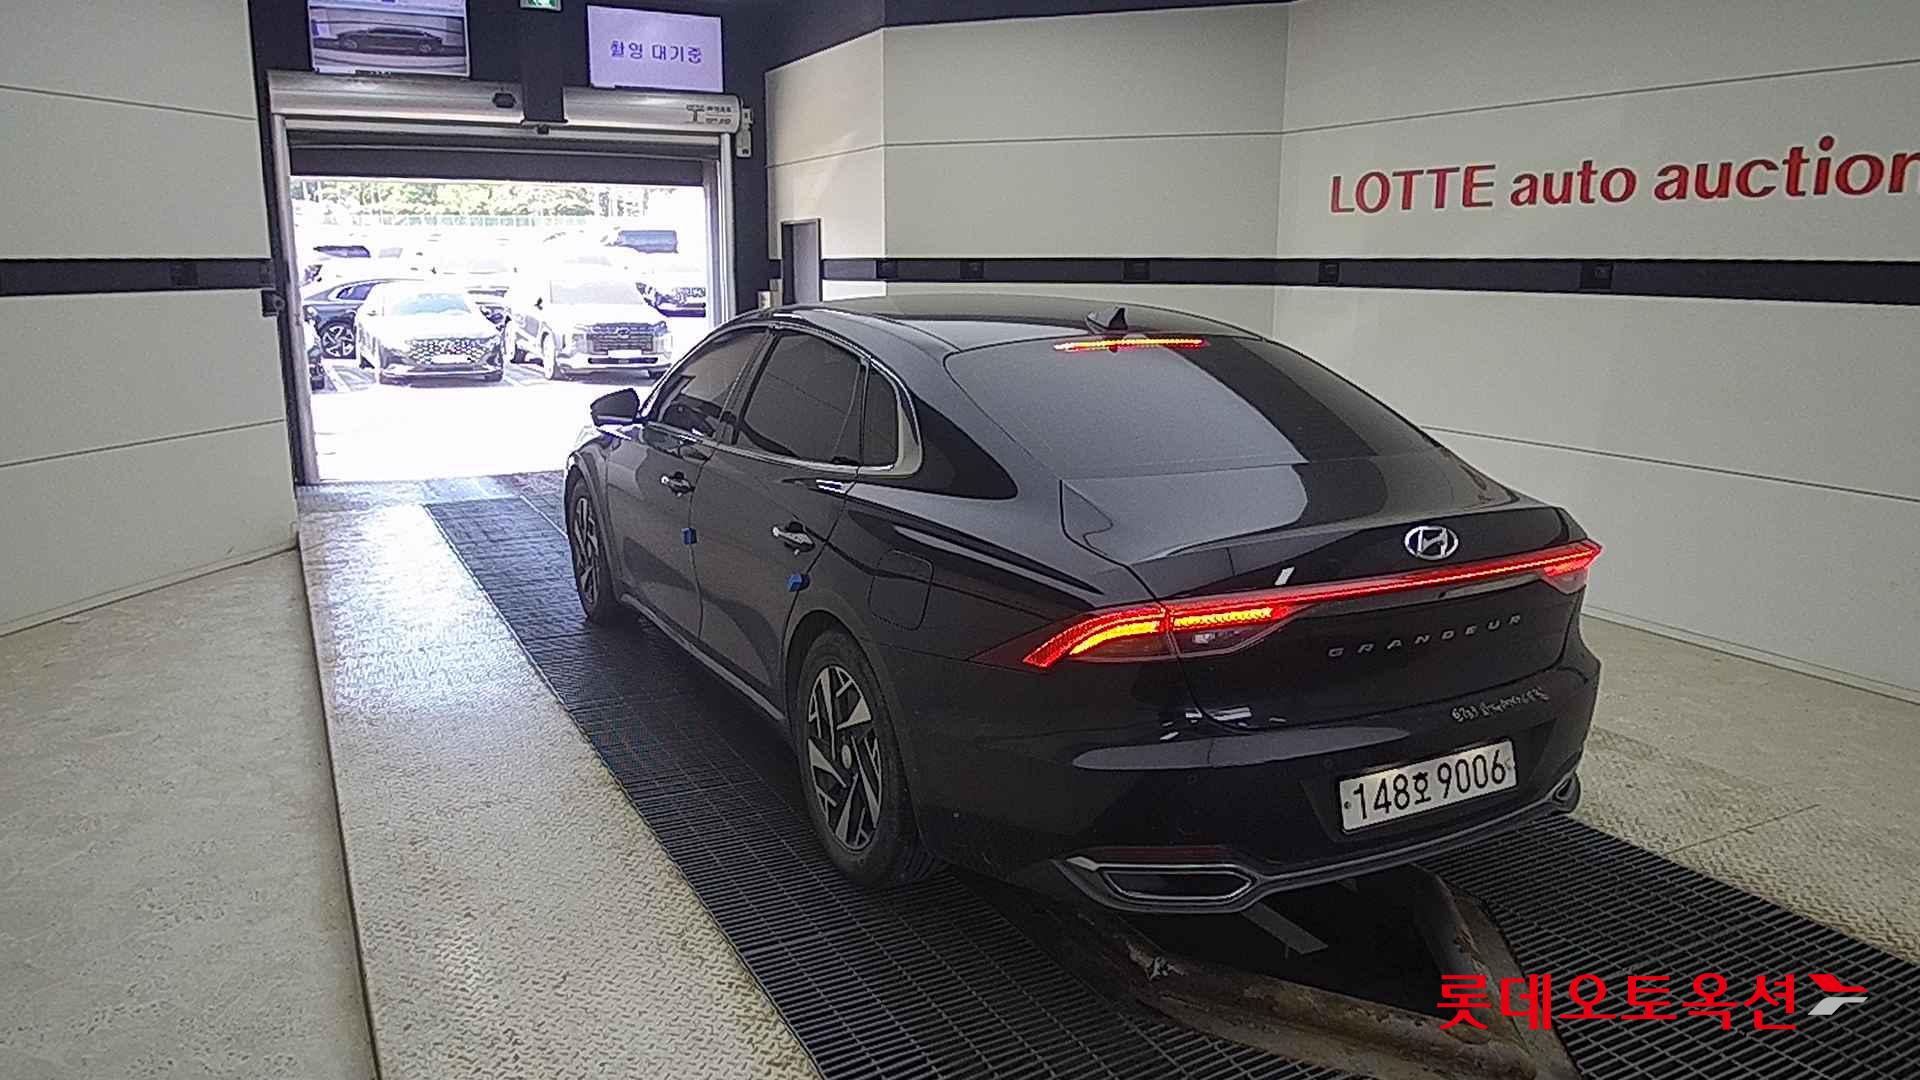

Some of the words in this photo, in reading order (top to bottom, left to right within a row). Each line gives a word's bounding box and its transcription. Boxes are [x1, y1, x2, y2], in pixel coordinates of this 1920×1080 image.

[651, 44, 702, 64] 대기중
[1330, 164, 1495, 214] LOTTE
[1510, 160, 1637, 206] auto
[1328, 615, 1521, 658] GRANDEUR
